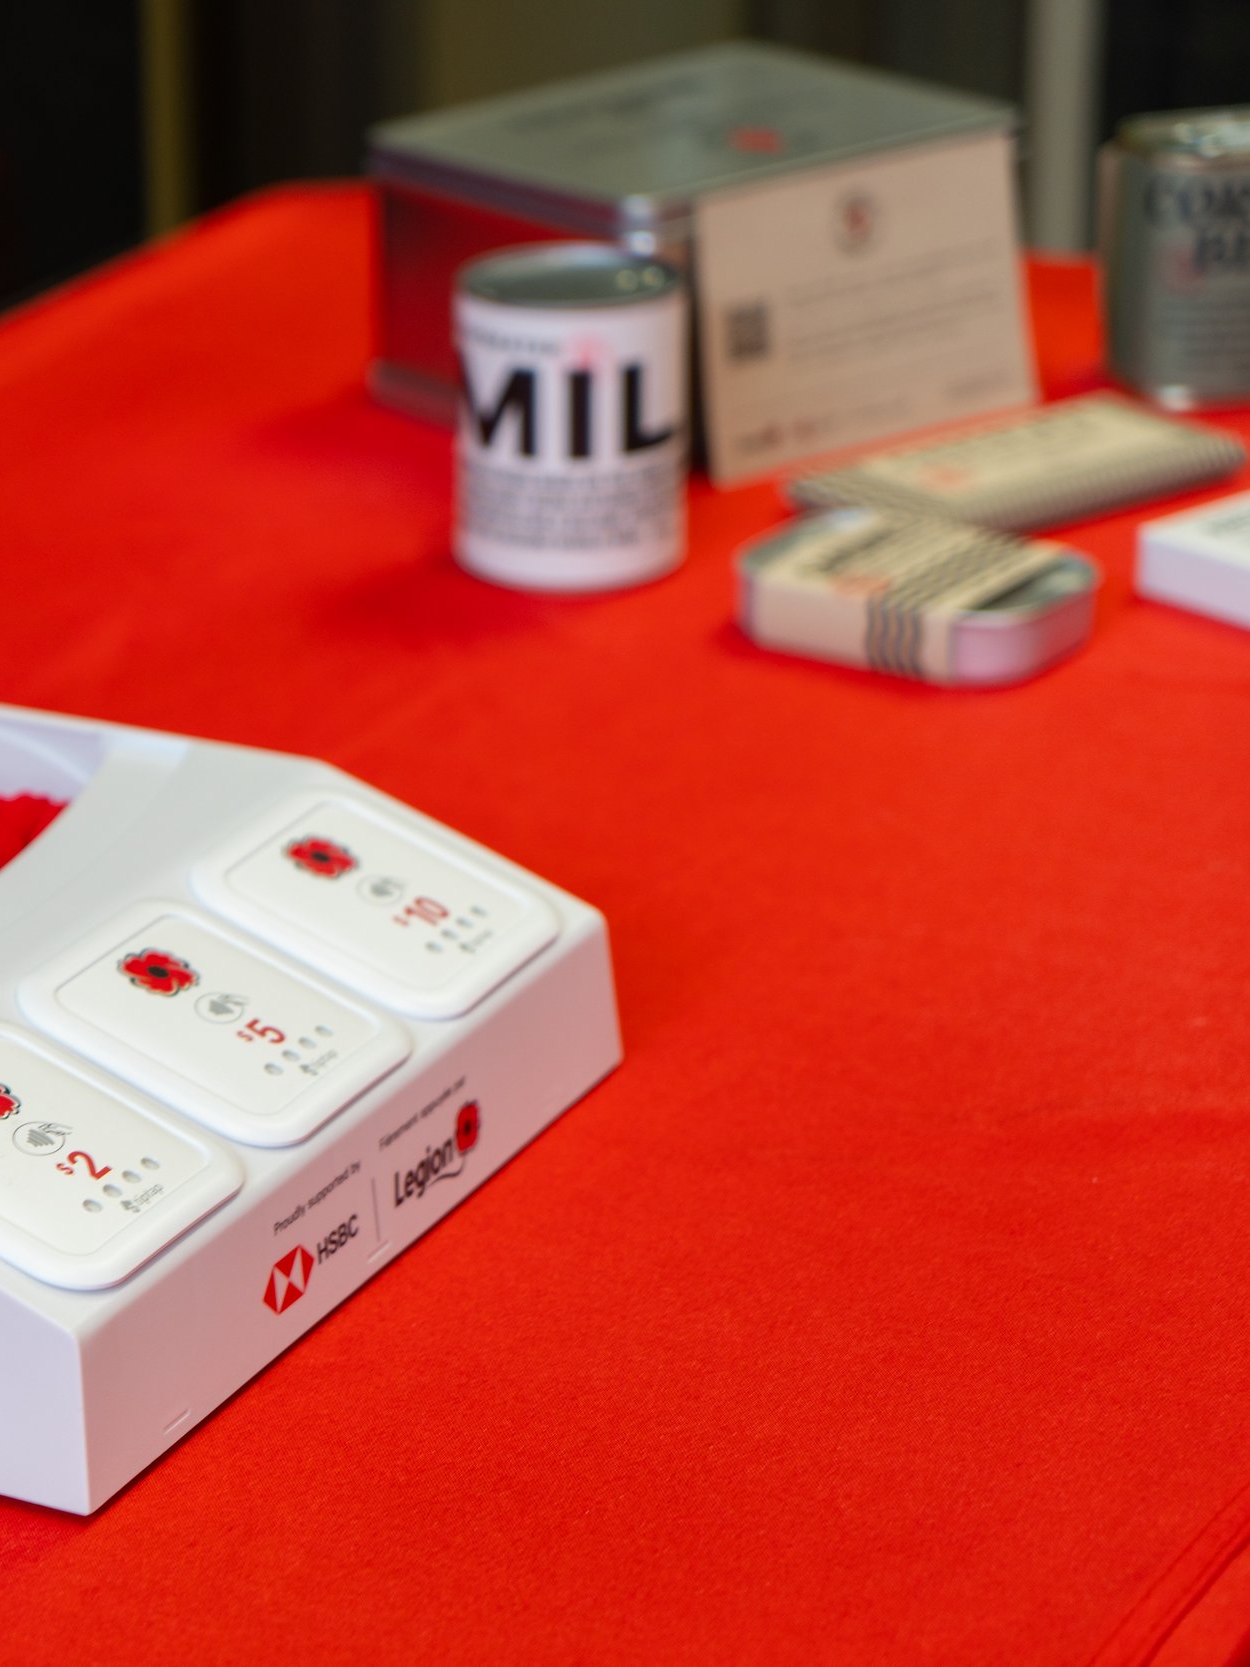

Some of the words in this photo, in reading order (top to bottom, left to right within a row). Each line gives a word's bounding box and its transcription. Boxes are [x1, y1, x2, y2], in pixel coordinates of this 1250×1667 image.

[307, 1167, 349, 1210] supported
[394, 1137, 455, 1208] Legion
[316, 1213, 359, 1266] HSBC
